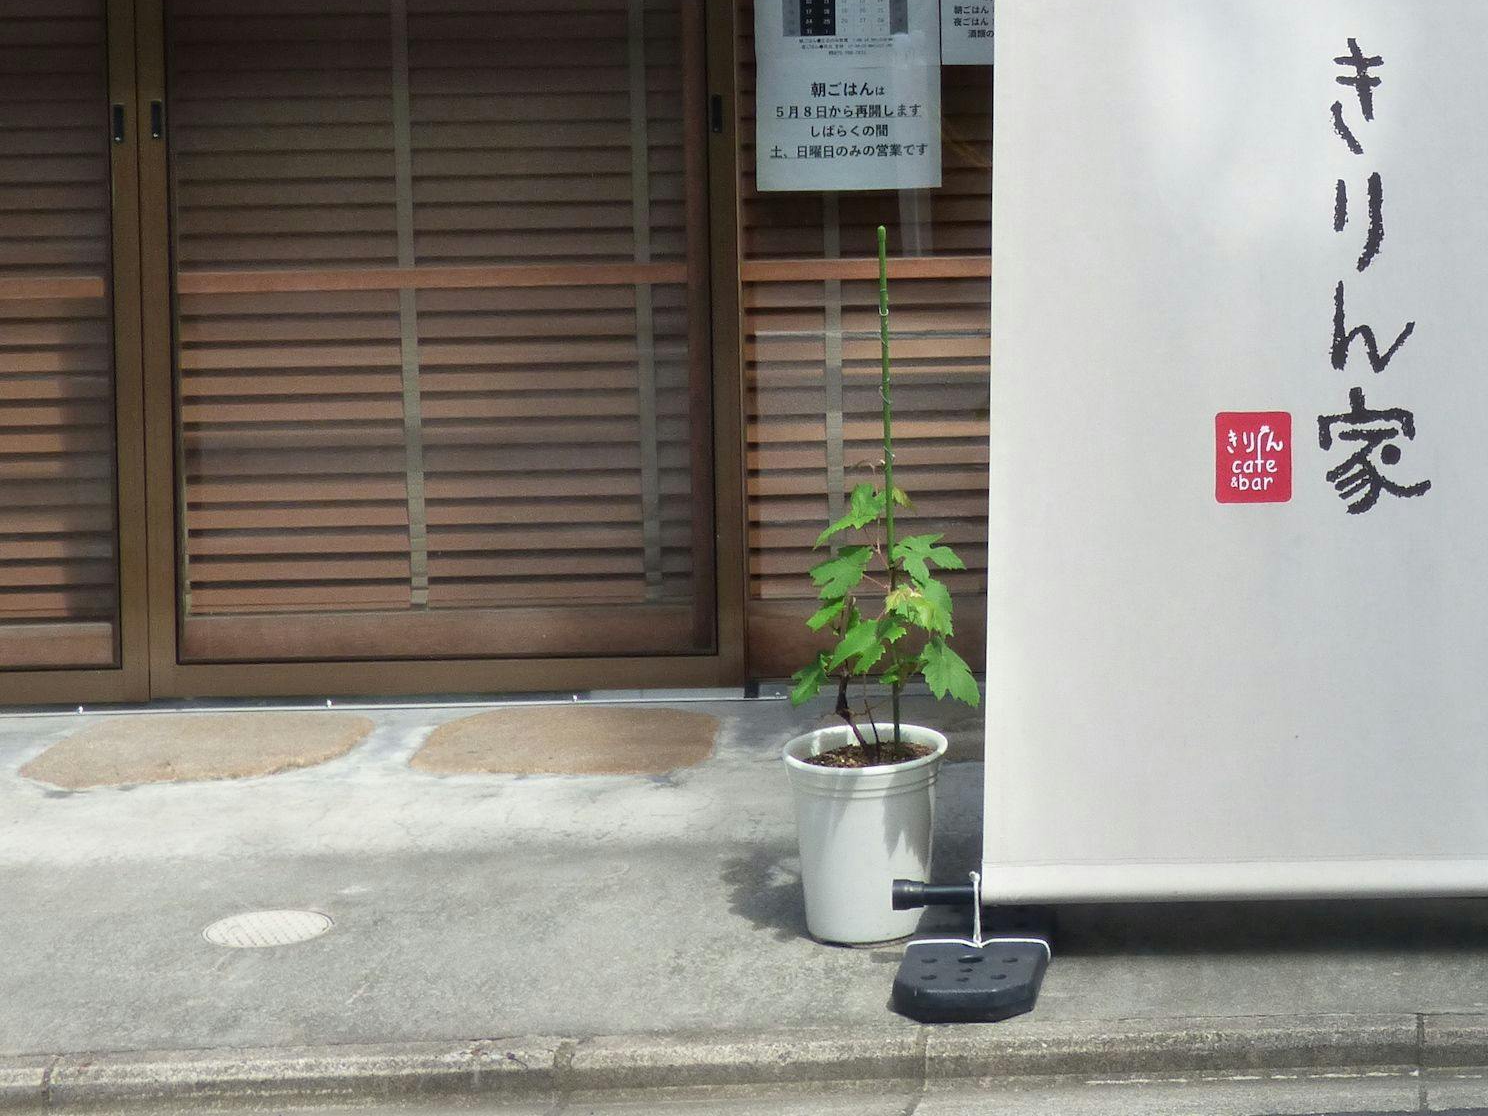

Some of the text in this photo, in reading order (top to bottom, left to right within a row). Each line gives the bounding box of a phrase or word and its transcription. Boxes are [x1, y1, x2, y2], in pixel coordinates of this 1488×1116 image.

[811, 82, 885, 97] 朝ごはんは
[776, 104, 922, 118] 5月8日から再開します
[810, 124, 889, 138] しばらくの間
[770, 143, 929, 159] 土、日曜日のみの営業です
[1317, 37, 1432, 515] きりん家
[1226, 429, 1284, 454] きりん
